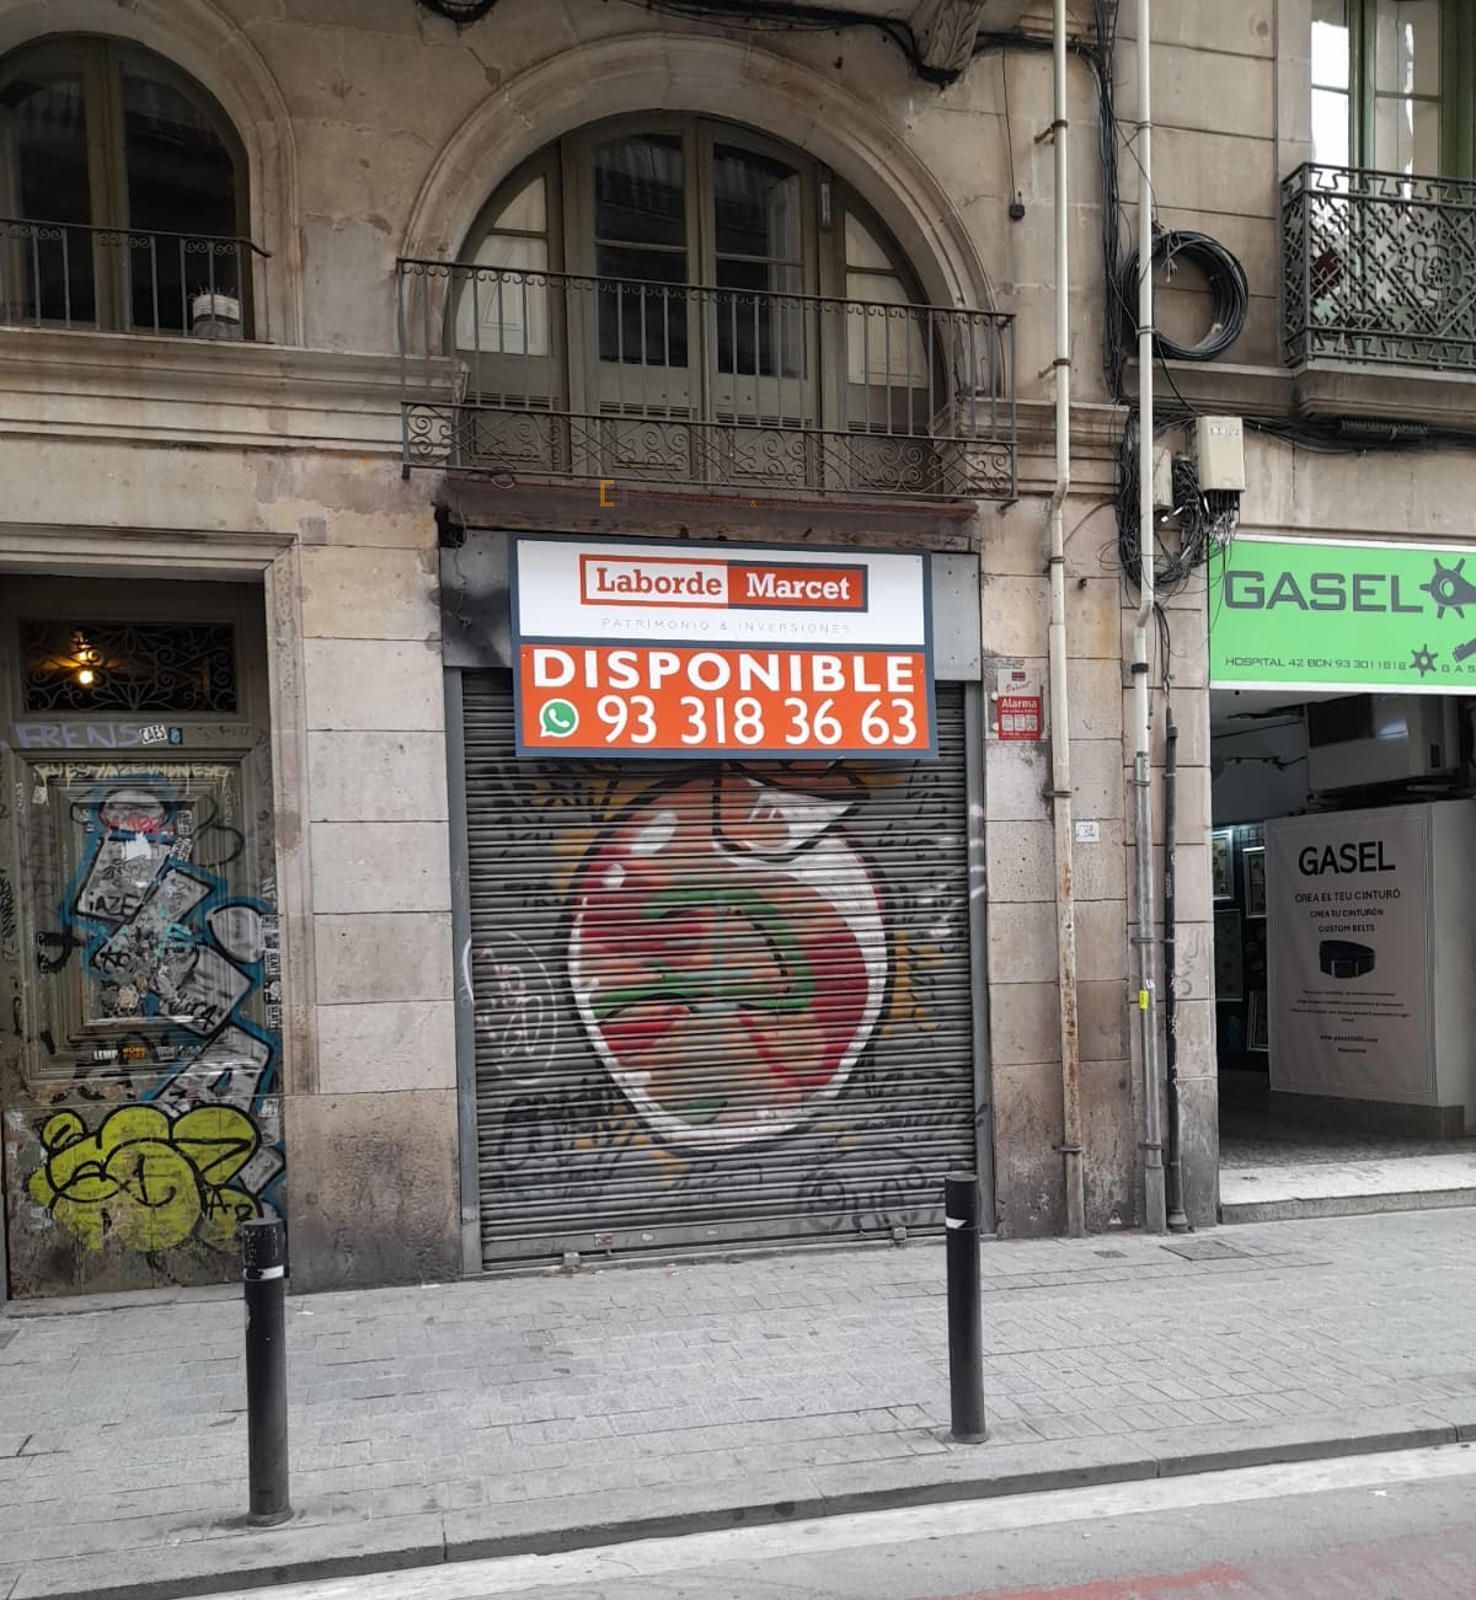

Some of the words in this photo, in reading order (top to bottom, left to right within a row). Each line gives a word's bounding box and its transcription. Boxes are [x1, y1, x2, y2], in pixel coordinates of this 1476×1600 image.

[597, 567, 723, 596] Laborde
[746, 572, 850, 601] Marcet
[1224, 570, 1423, 613] GASEL
[602, 617, 710, 631] PATRIMONIO
[719, 621, 728, 631] &
[739, 622, 850, 634] INVERSIONES
[533, 649, 915, 693] DISPONIBLE
[1225, 657, 1286, 668] HOSPITAL
[1288, 658, 1304, 668] 42
[1307, 659, 1332, 668] BCN
[1335, 659, 1350, 669] 93
[1001, 698, 1038, 709] Alarma
[597, 695, 657, 744] 93
[681, 696, 765, 745] 318
[785, 698, 843, 745] 36
[861, 698, 917, 745] 63
[1298, 840, 1396, 876] GASEL
[1295, 891, 1320, 903] CREA
[1321, 892, 1333, 902] EL
[1334, 892, 1352, 902] TEU
[1354, 888, 1401, 901] CINTURÓ
[1318, 924, 1351, 933] CUSTOM
